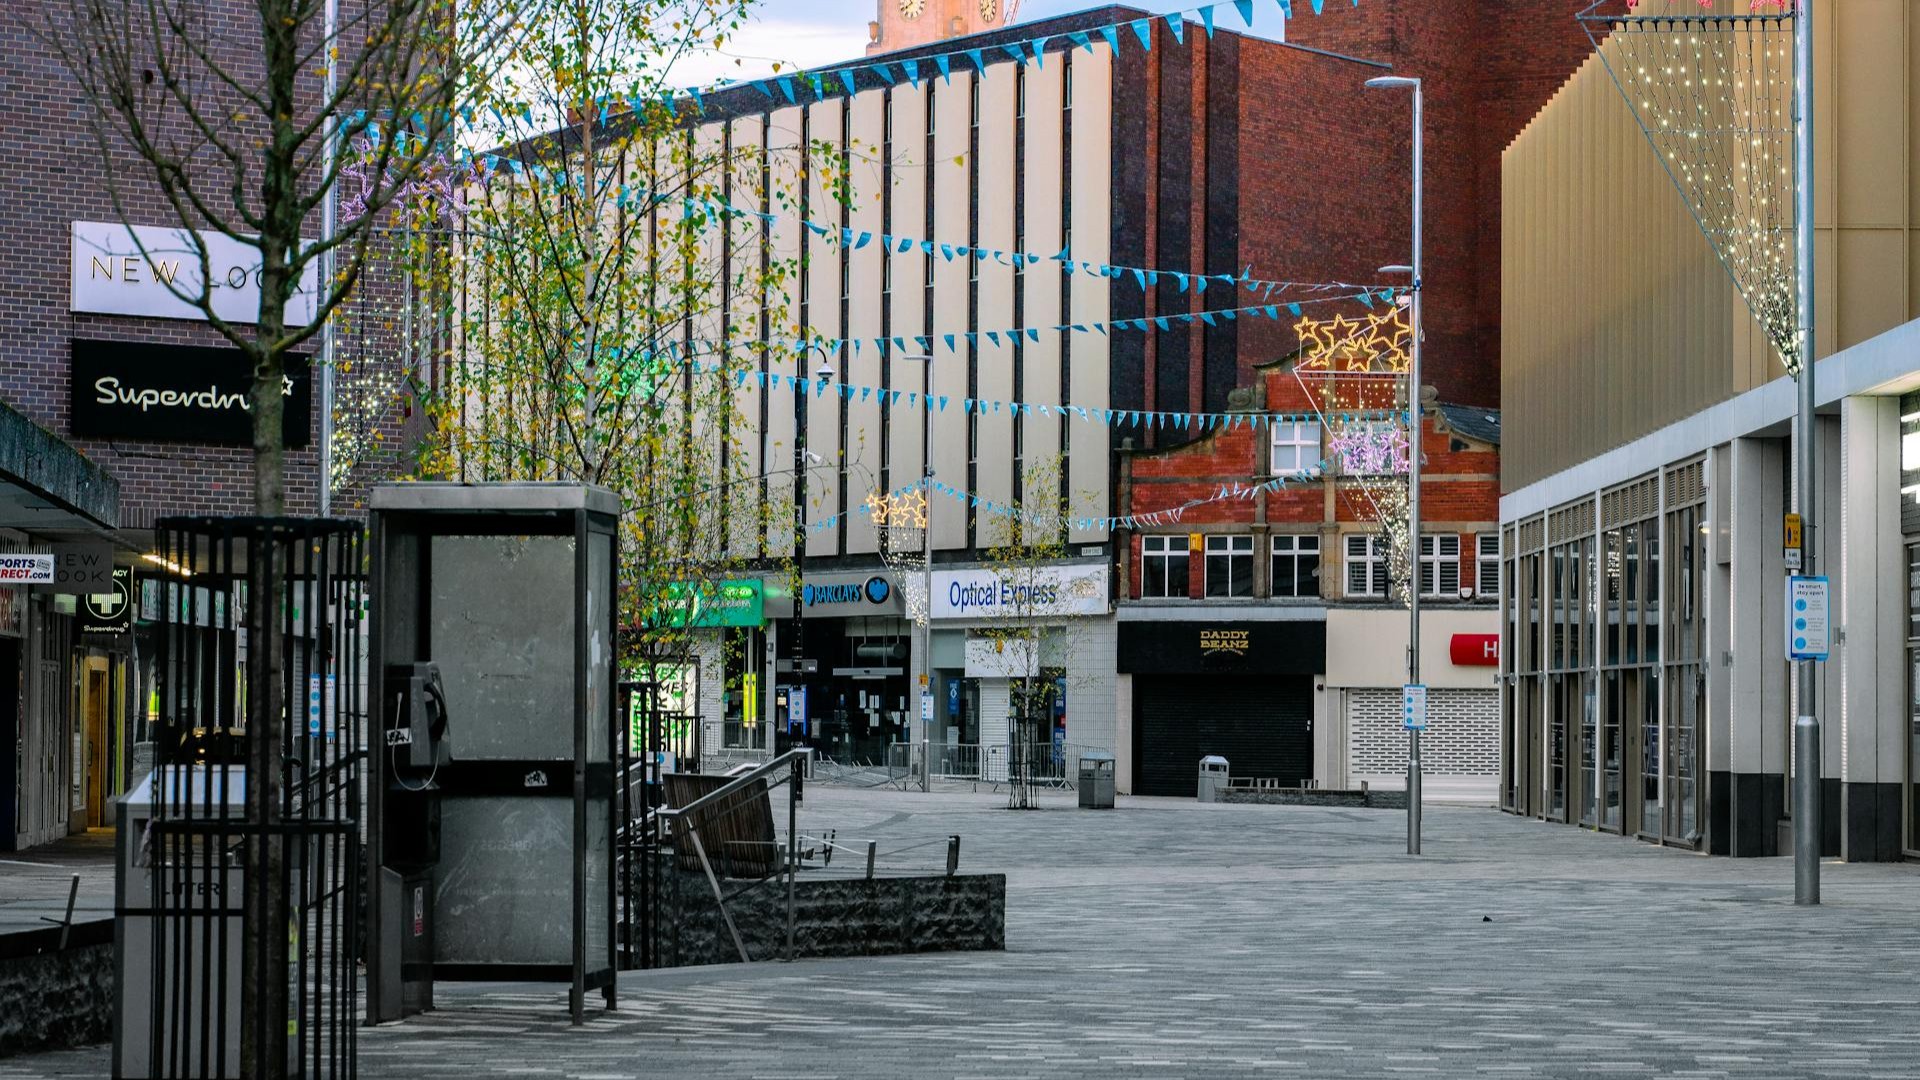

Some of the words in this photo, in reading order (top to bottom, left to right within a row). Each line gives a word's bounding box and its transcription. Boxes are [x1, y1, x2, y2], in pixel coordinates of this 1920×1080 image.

[91, 255, 179, 285] NEW
[95, 376, 250, 412] Superdru
[57, 570, 104, 583] OOK
[815, 584, 861, 603] BARCLAYS
[949, 581, 996, 612] Optical
[1001, 579, 1057, 611] Express
[83, 624, 125, 634] Superdrug
[1200, 630, 1248, 639] DADDY
[1200, 640, 1248, 649] BEANZ
